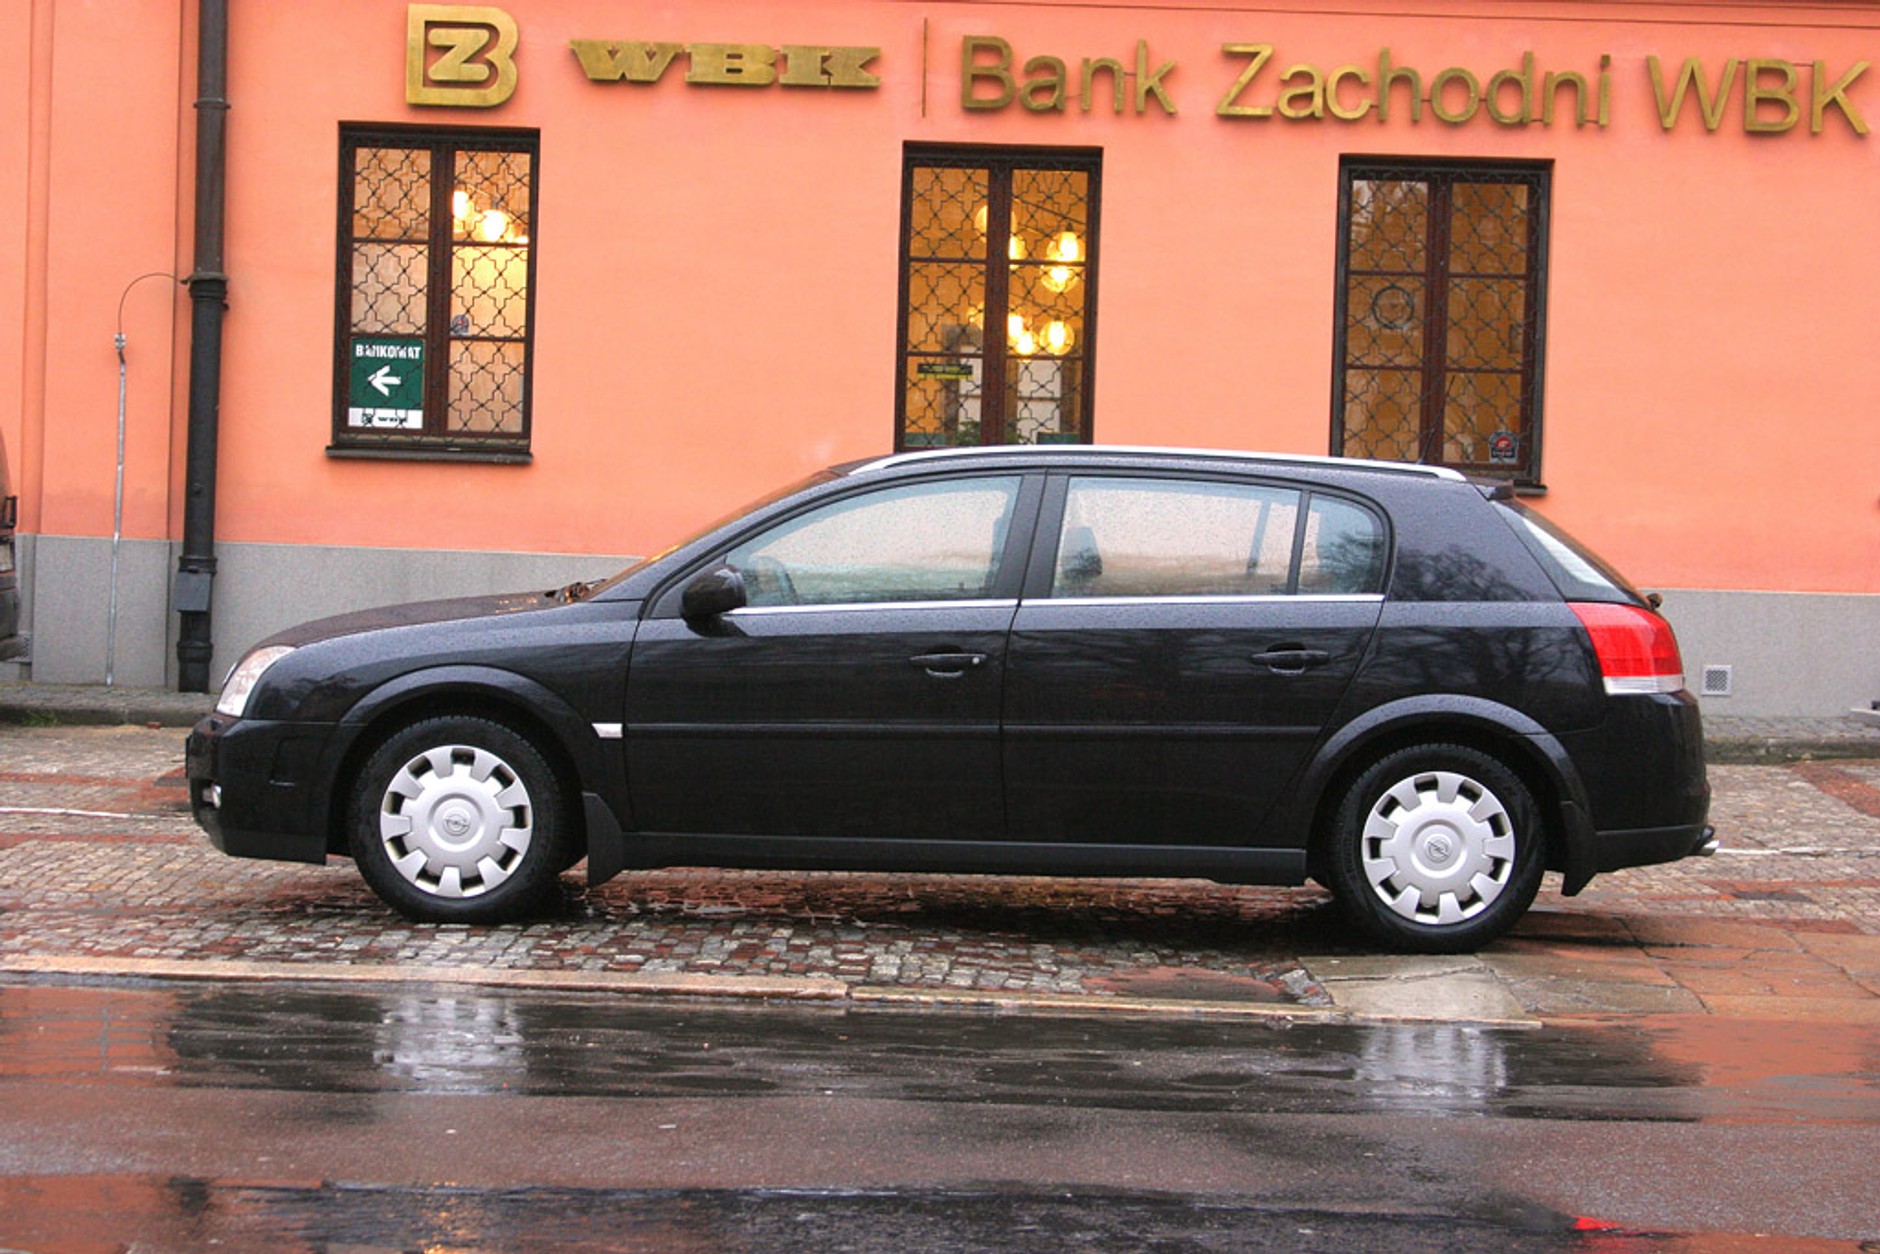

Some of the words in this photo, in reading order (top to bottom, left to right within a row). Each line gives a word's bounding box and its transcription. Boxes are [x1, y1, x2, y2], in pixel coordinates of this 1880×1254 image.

[569, 40, 880, 87] WBK
[962, 35, 1178, 115] Bank
[1216, 43, 1611, 129] Zachodni
[1646, 55, 1871, 135] WBK
[355, 344, 421, 359] BANKOMAT
